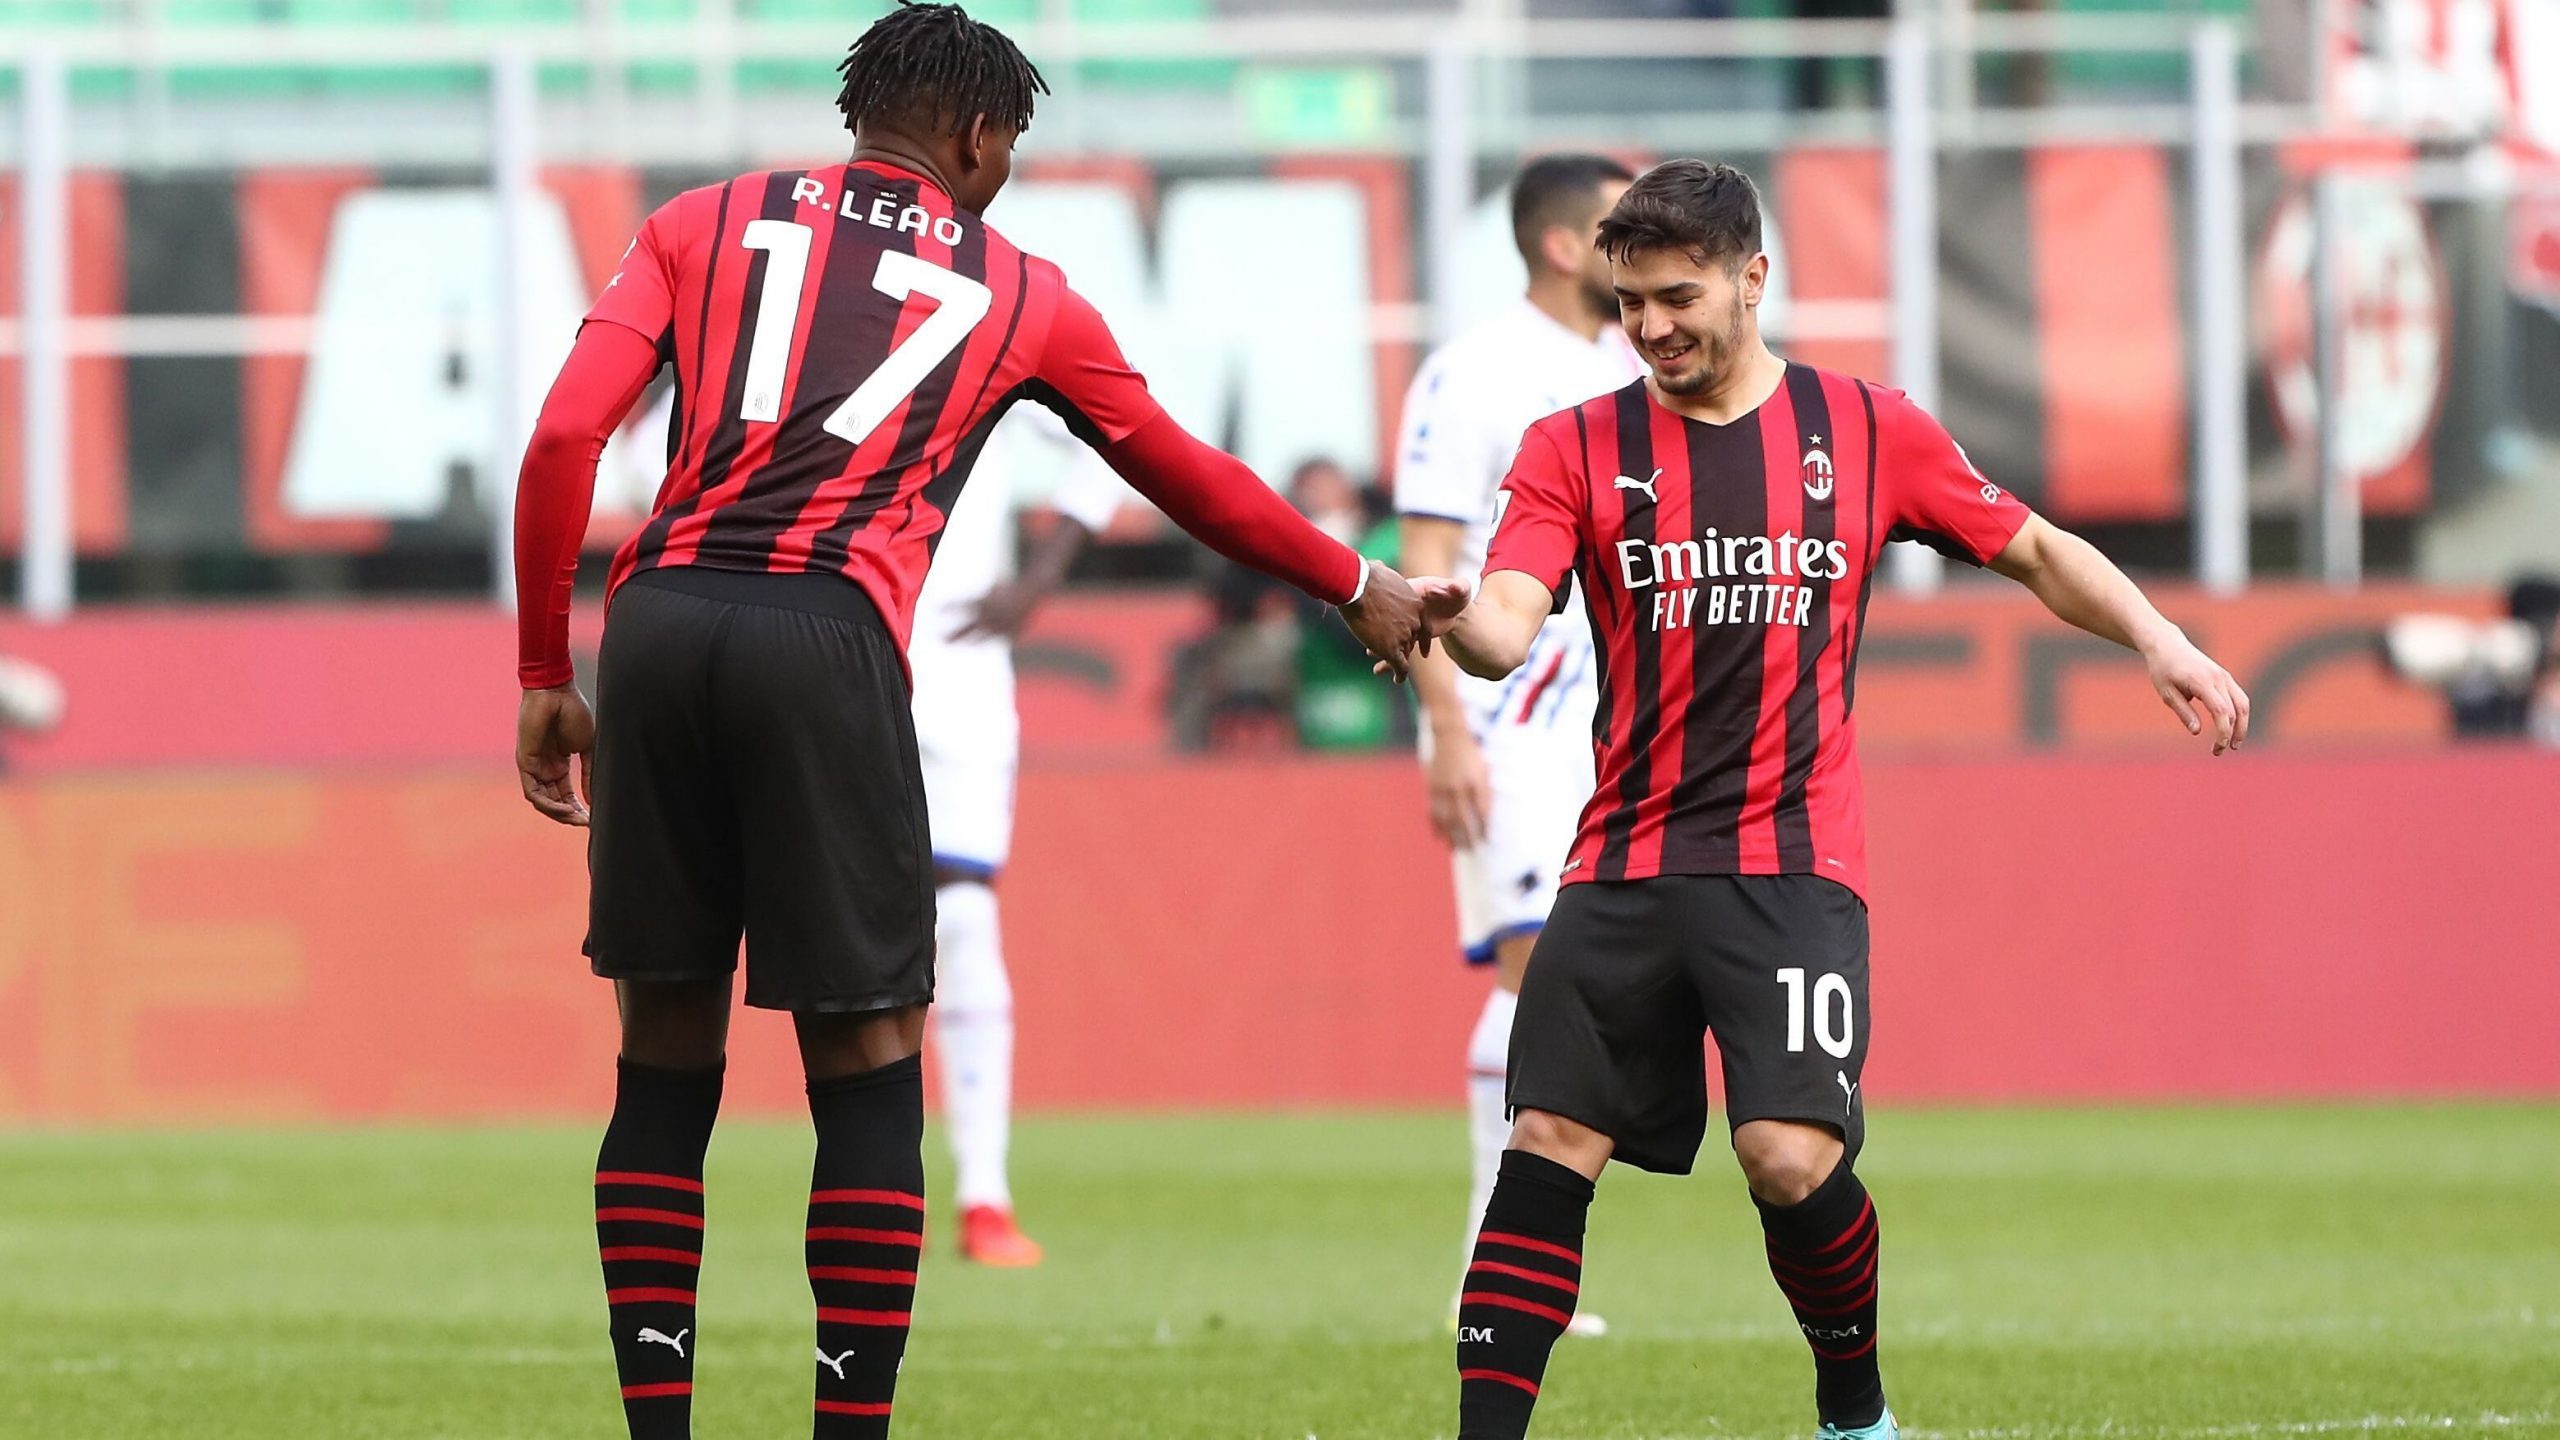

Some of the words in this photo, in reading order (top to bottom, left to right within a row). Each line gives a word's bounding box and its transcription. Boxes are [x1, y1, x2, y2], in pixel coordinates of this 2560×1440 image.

[739, 219, 993, 446] 17
[1615, 527, 1848, 589] Emirates
[1652, 587, 1698, 632] FLY
[1708, 584, 1813, 627] BETTER
[1776, 967, 1853, 1059] 10
[1456, 1326, 1495, 1344] CM
